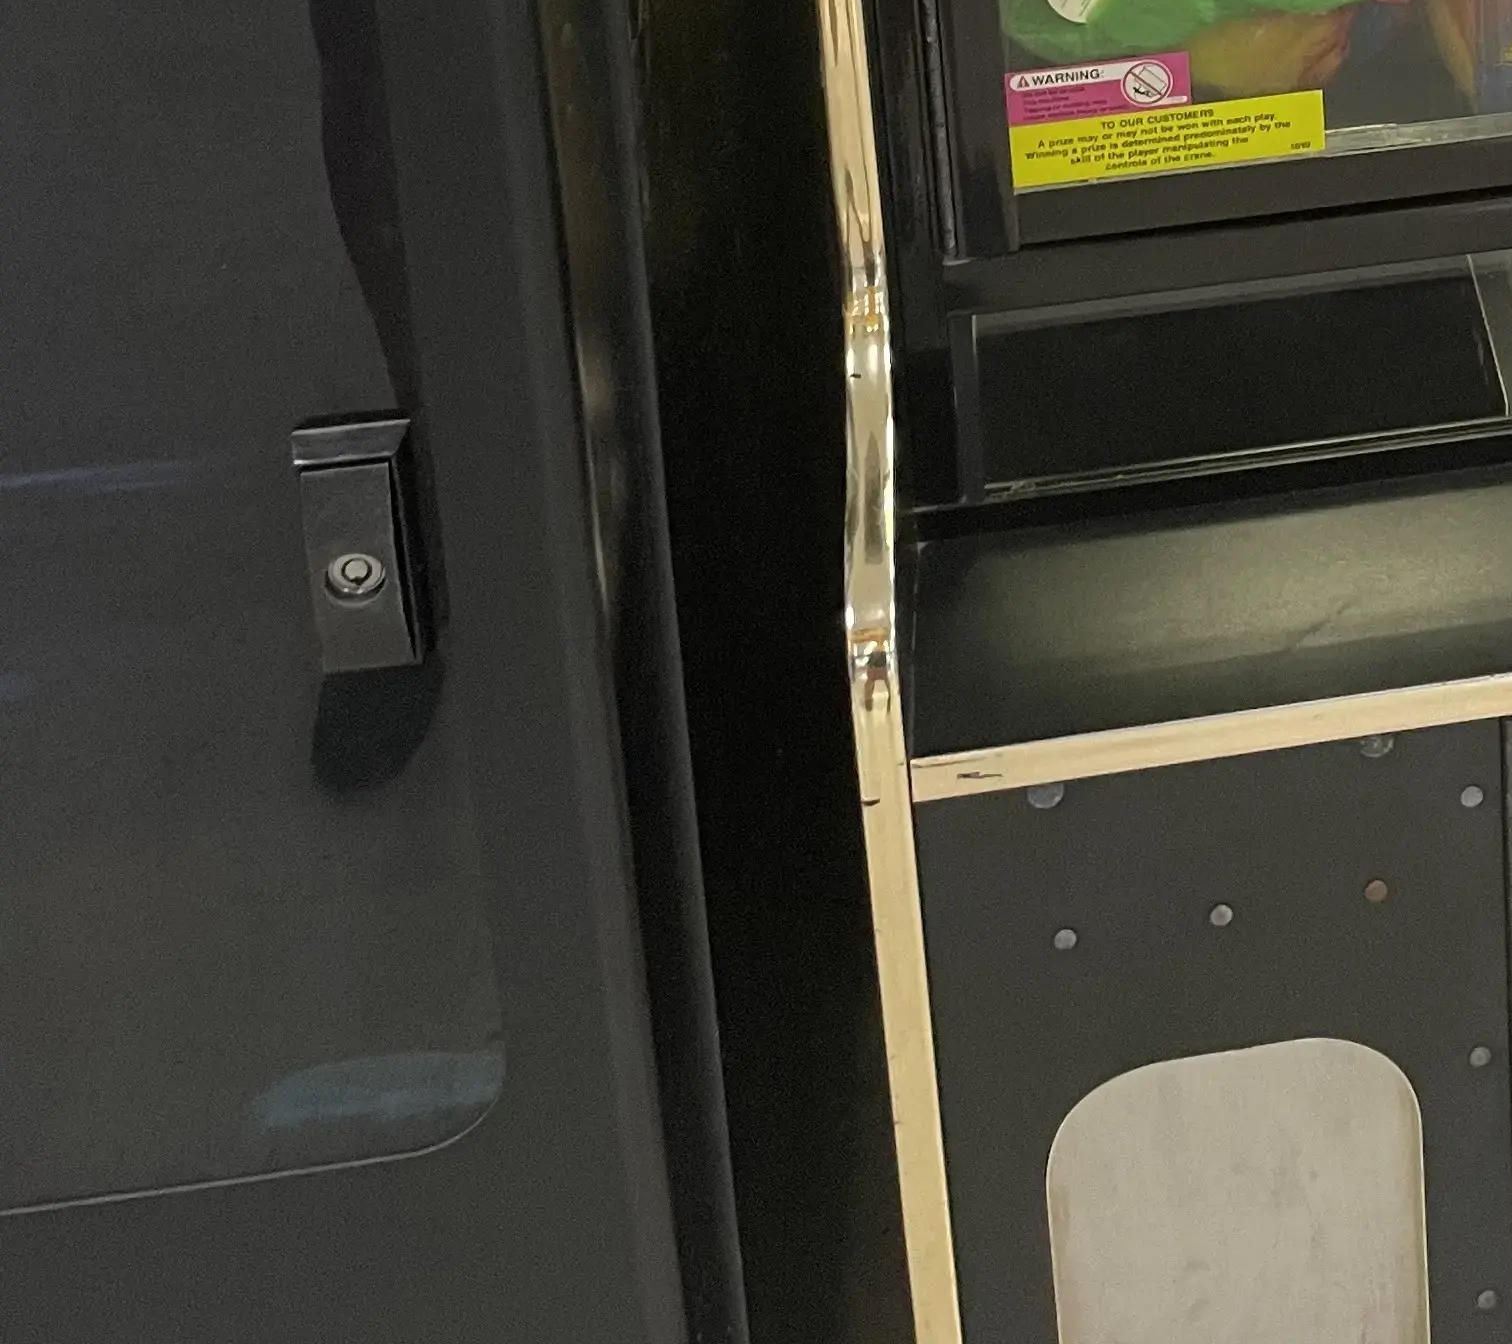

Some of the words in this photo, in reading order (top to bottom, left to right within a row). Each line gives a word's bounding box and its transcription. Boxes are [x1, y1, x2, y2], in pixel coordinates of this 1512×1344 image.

[1101, 120, 1116, 130] TO
[1119, 117, 1144, 128] OUR
[1147, 108, 1215, 124] CUSTOMERS
[1259, 123, 1272, 133] by
[1274, 120, 1291, 130] the
[1037, 140, 1045, 149] A
[1102, 132, 1113, 140] or
[1116, 130, 1137, 140] may
[1140, 125, 1158, 135] not
[1160, 124, 1174, 133] be
[1176, 123, 1199, 131] won
[1201, 117, 1224, 129] with
[1226, 114, 1251, 126] each
[1107, 150, 1125, 160] the
[1231, 136, 1249, 146] the
[1163, 154, 1181, 164] the
